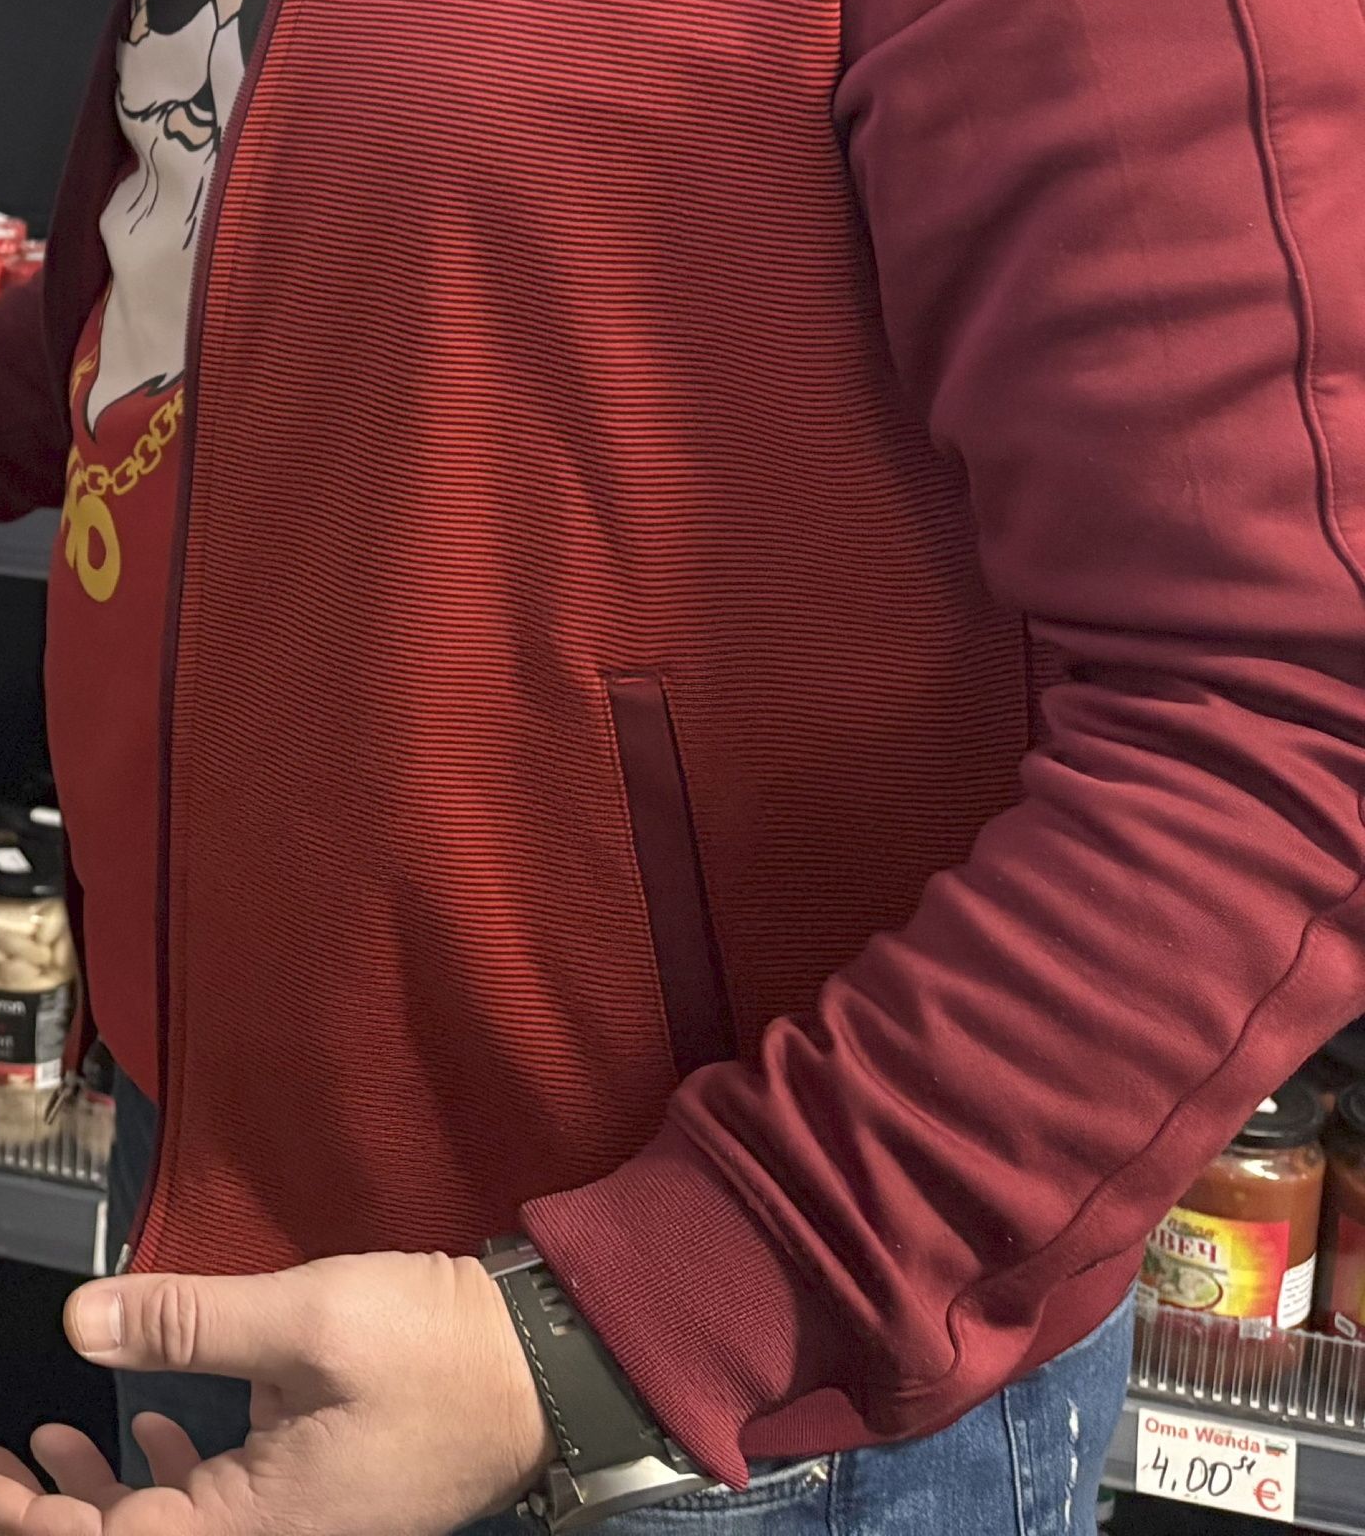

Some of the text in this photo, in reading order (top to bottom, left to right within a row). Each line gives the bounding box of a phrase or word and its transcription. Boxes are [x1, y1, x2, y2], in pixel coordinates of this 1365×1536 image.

[1145, 1417, 1262, 1455] Oma Wenda
[1150, 1446, 1283, 1512] 4,00 €
